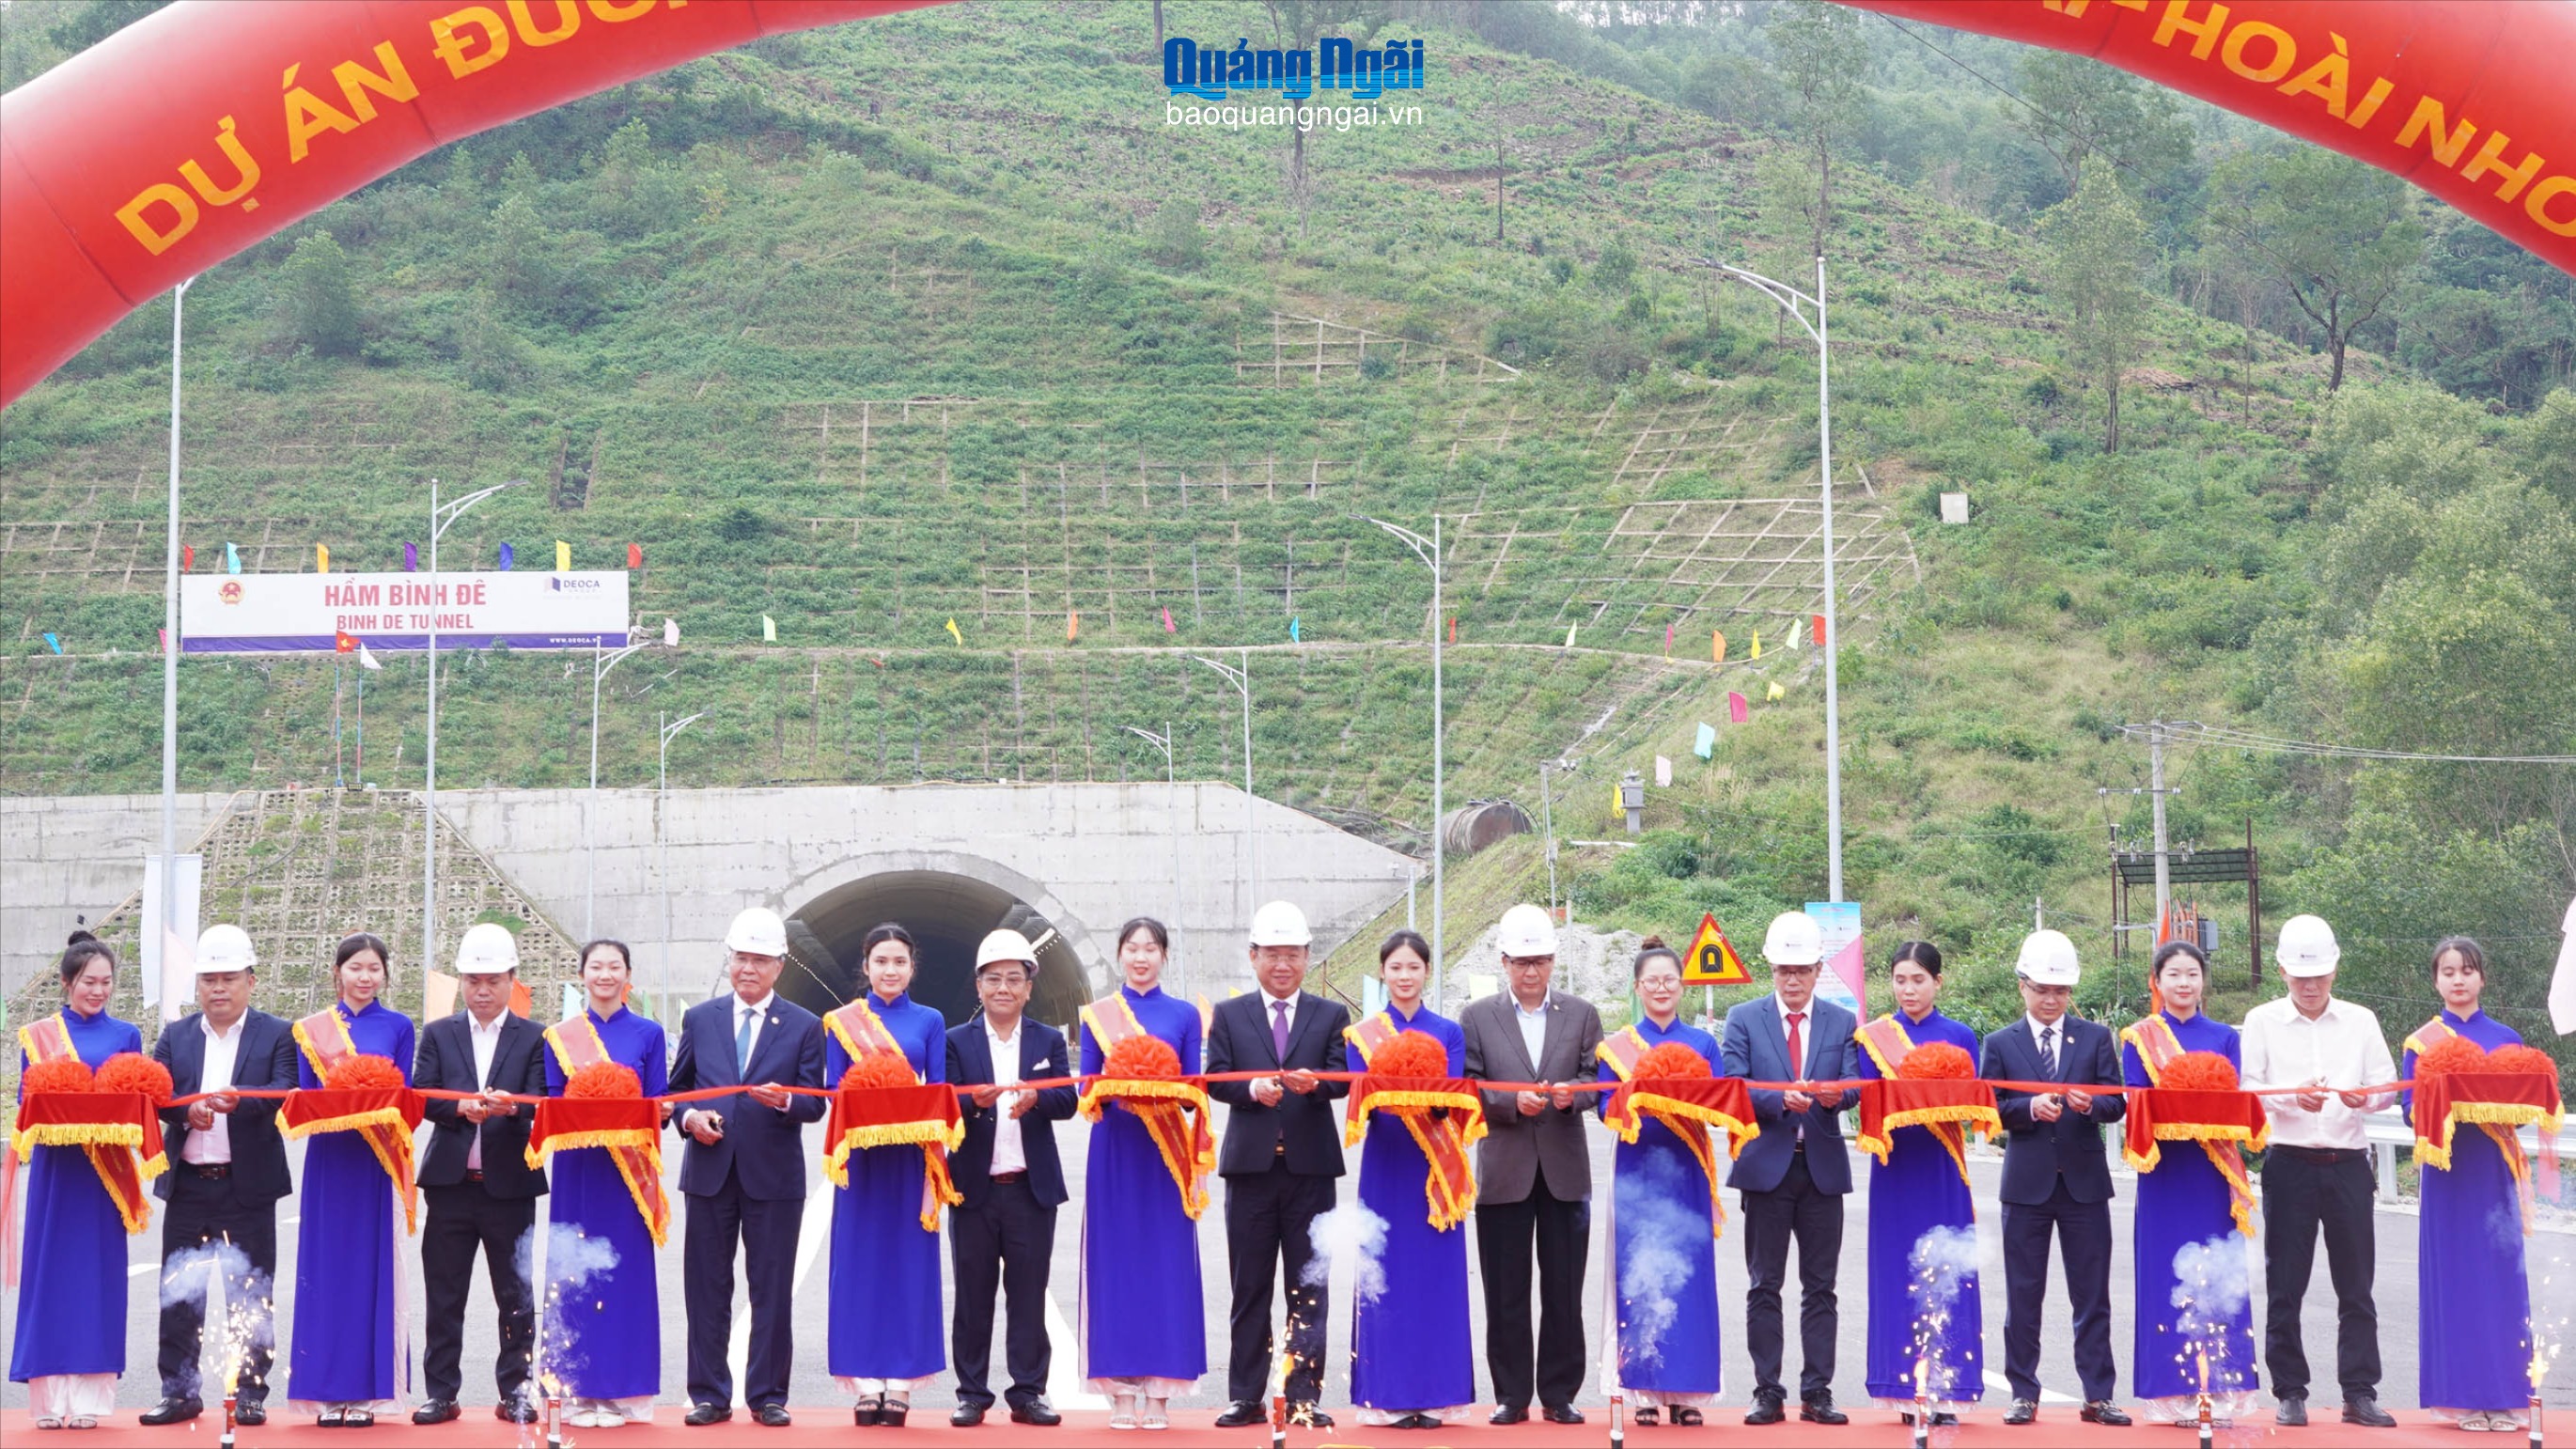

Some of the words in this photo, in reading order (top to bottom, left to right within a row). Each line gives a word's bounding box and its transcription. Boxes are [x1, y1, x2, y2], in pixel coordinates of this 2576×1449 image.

[2152, 0, 2395, 130] HOÀI
[115, 115, 260, 256] DỰ
[283, 40, 420, 164] ÁN
[324, 577, 380, 606] HẦM
[389, 580, 447, 606] BÌNH
[456, 579, 486, 605] ĐÊ
[563, 580, 601, 588] DEOCA
[336, 615, 377, 630] BINH
[383, 615, 403, 629] DE
[410, 614, 474, 629] TUNNEL
